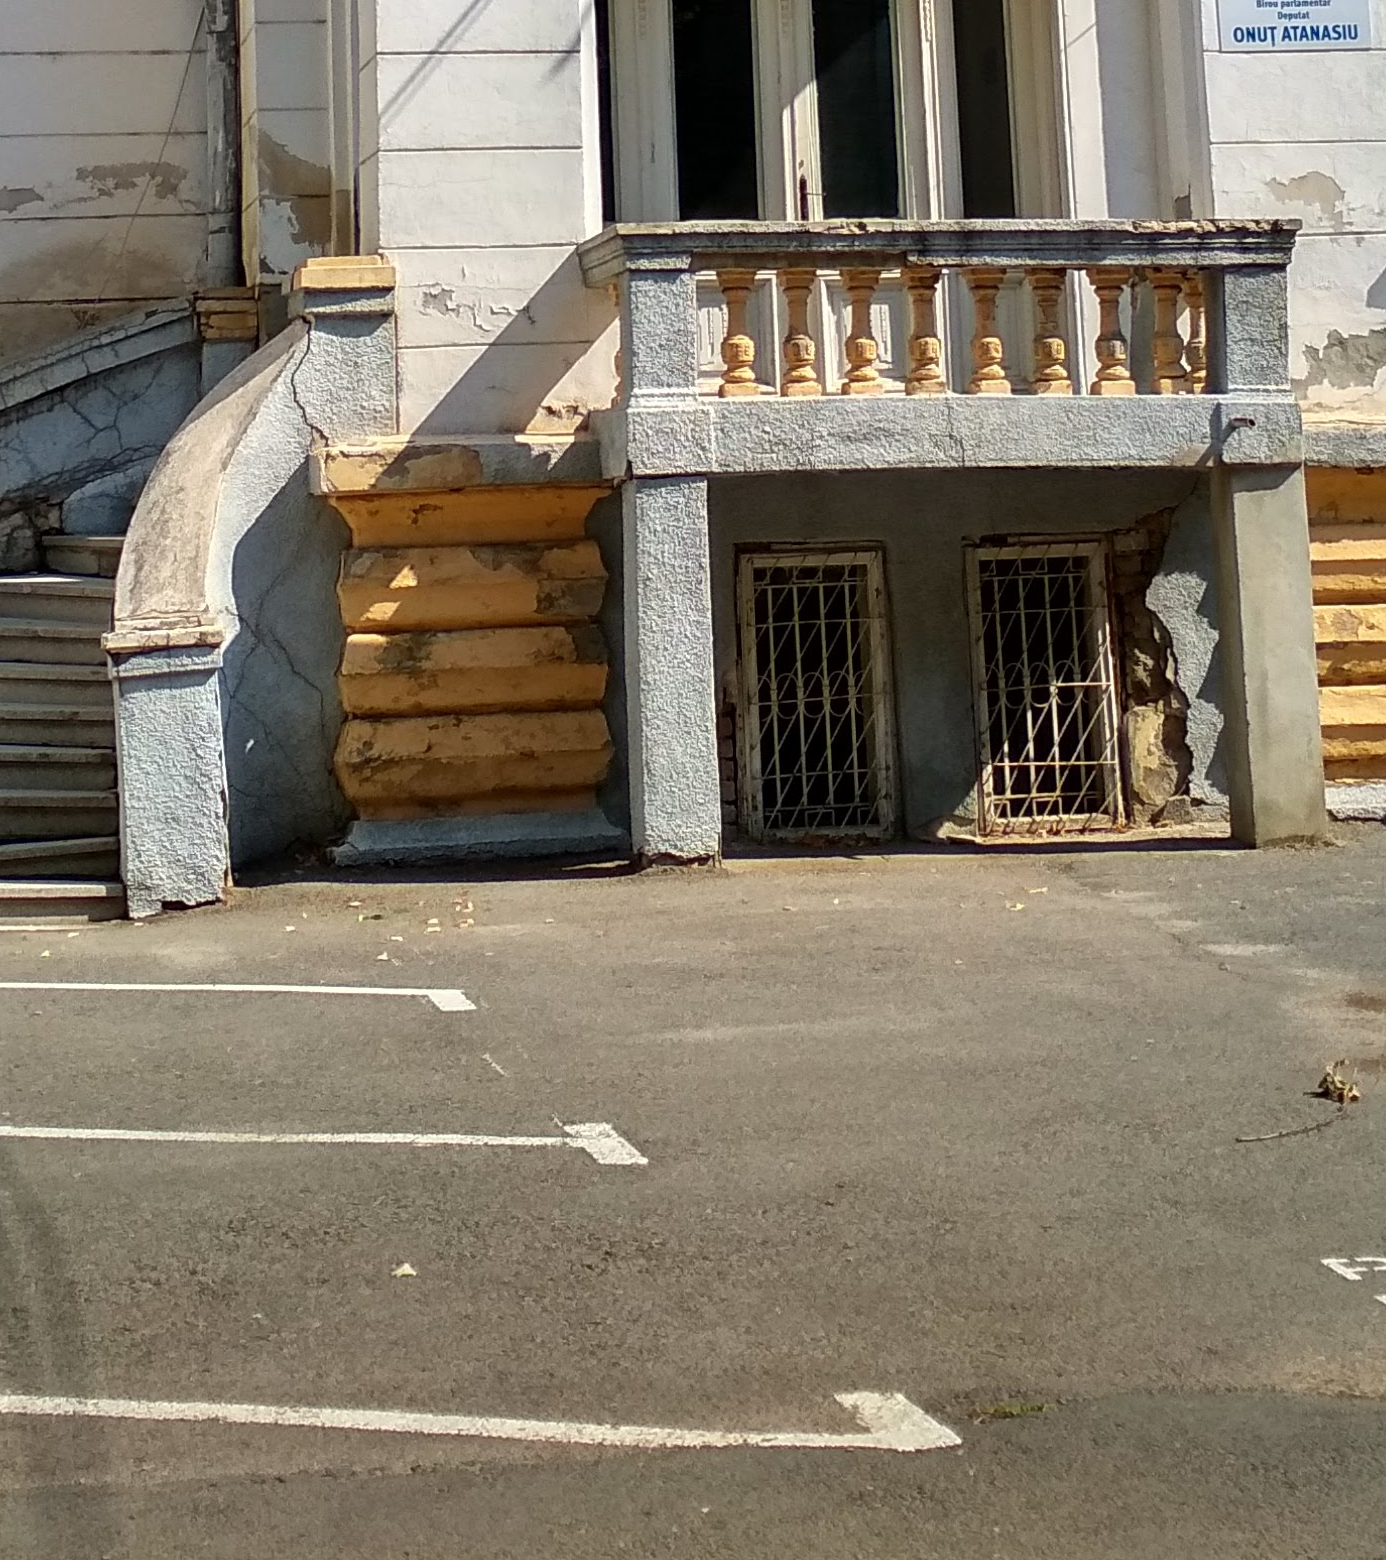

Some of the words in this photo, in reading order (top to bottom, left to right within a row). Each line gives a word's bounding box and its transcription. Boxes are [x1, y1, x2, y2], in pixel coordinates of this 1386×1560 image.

[1256, 0, 1278, 8] Birou
[1280, 0, 1331, 10] parlamentar
[1277, 11, 1310, 21] Deputat
[1233, 26, 1277, 47] ONUȚ
[1281, 24, 1358, 42] ATANASIU
